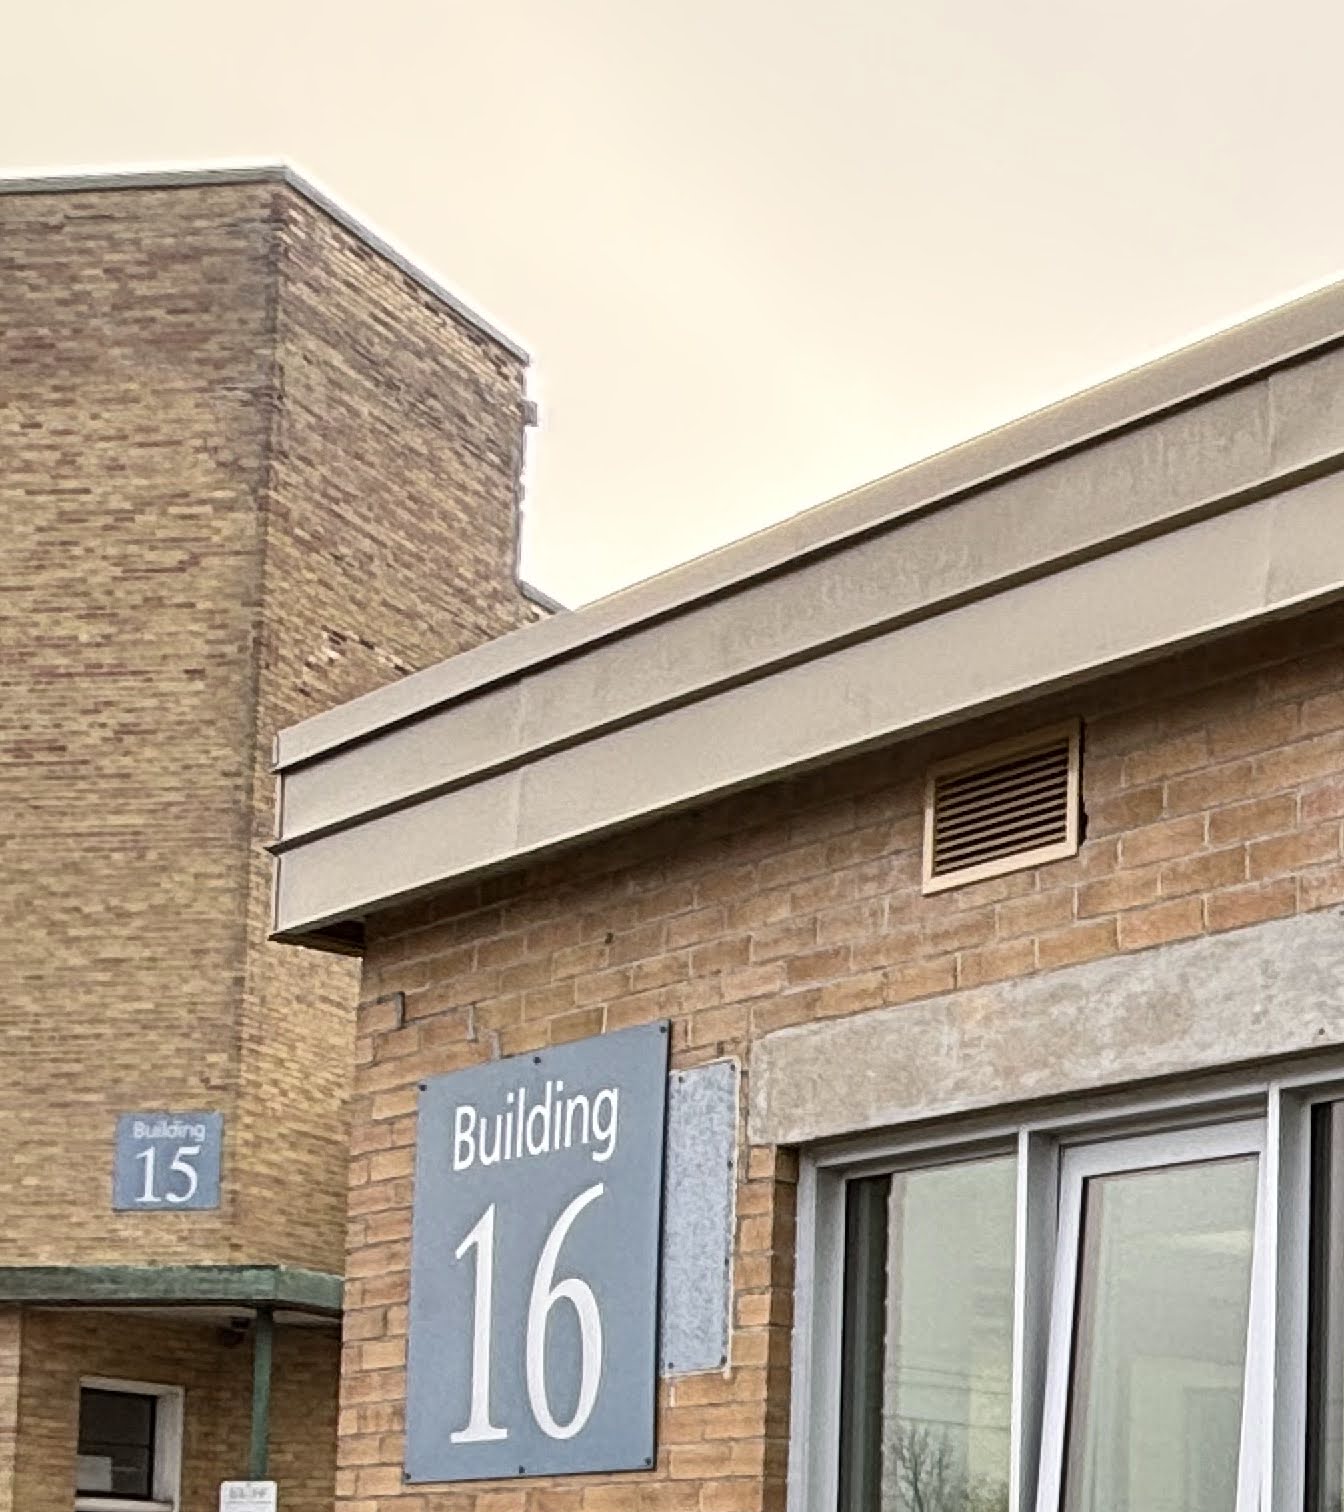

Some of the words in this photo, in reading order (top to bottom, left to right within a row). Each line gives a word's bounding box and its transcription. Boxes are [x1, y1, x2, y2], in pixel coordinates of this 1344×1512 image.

[133, 1120, 206, 1142] Building
[453, 1080, 619, 1171] Building
[134, 1145, 201, 1203] 15
[450, 1183, 604, 1443] 16
